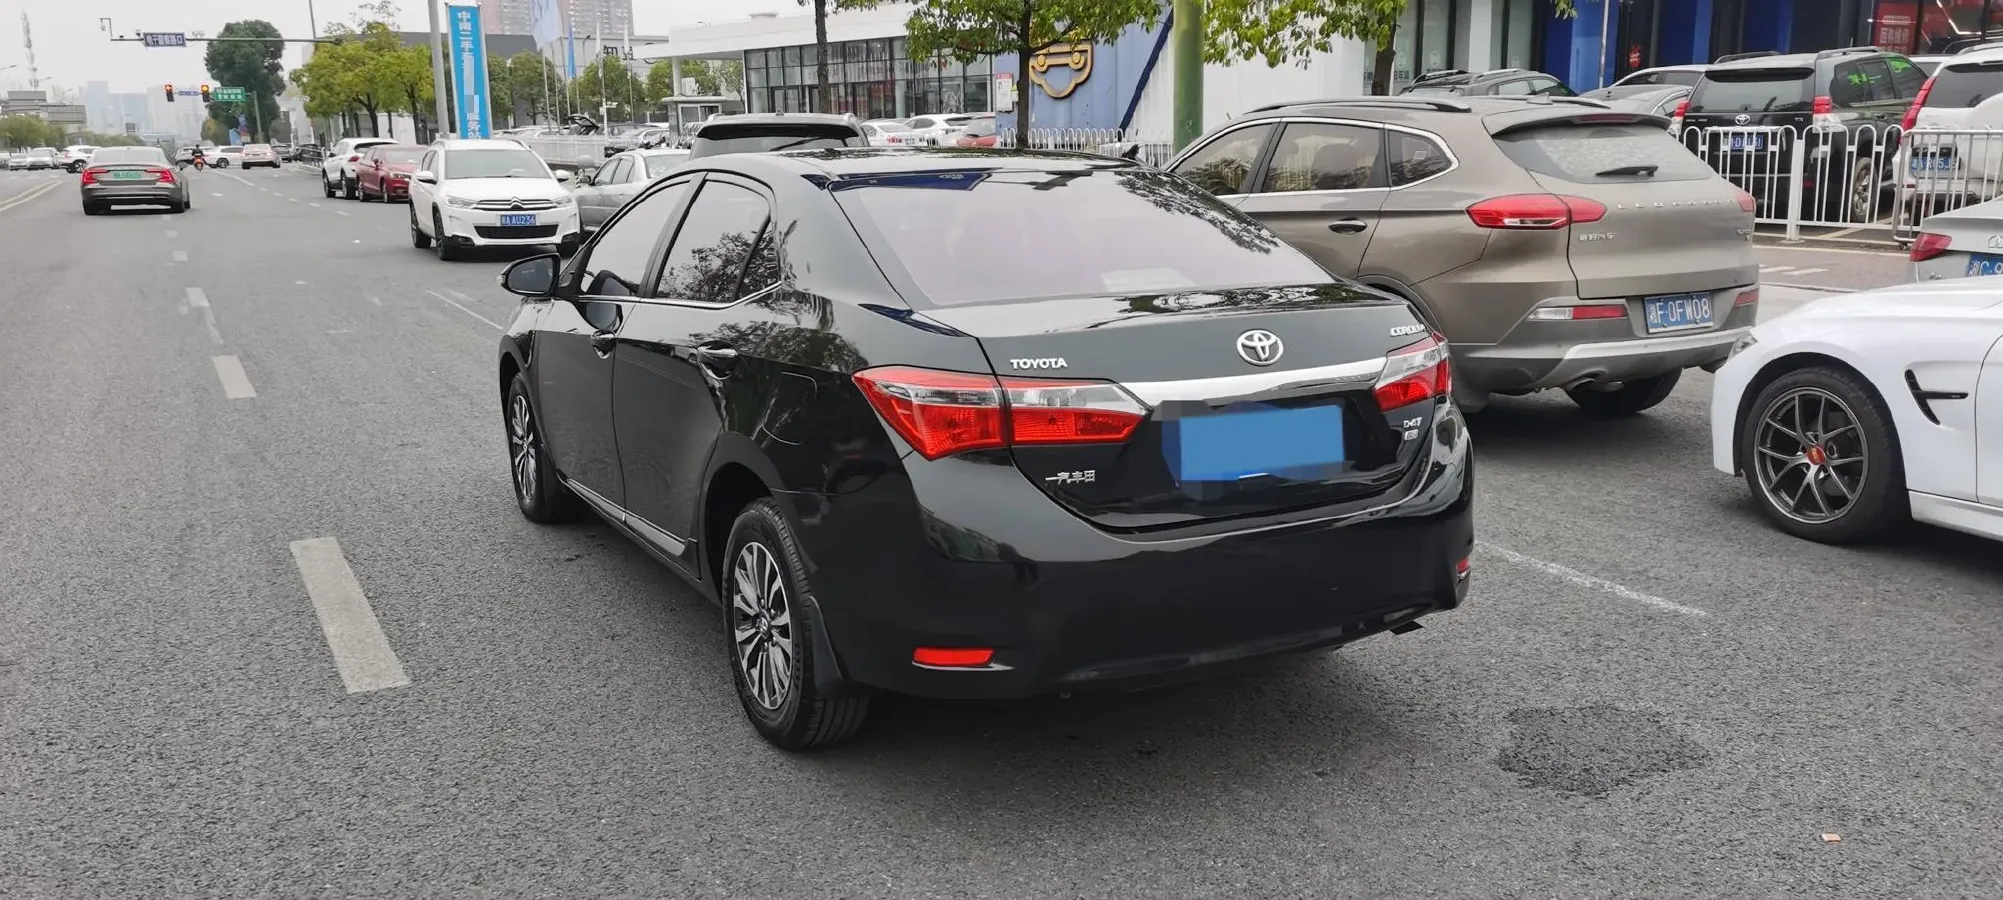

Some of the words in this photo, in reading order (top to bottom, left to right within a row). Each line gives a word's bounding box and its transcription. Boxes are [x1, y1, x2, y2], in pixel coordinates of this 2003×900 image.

[1009, 357, 1068, 369] TOYOTA
[1045, 470, 1095, 485] 一汽丰田
